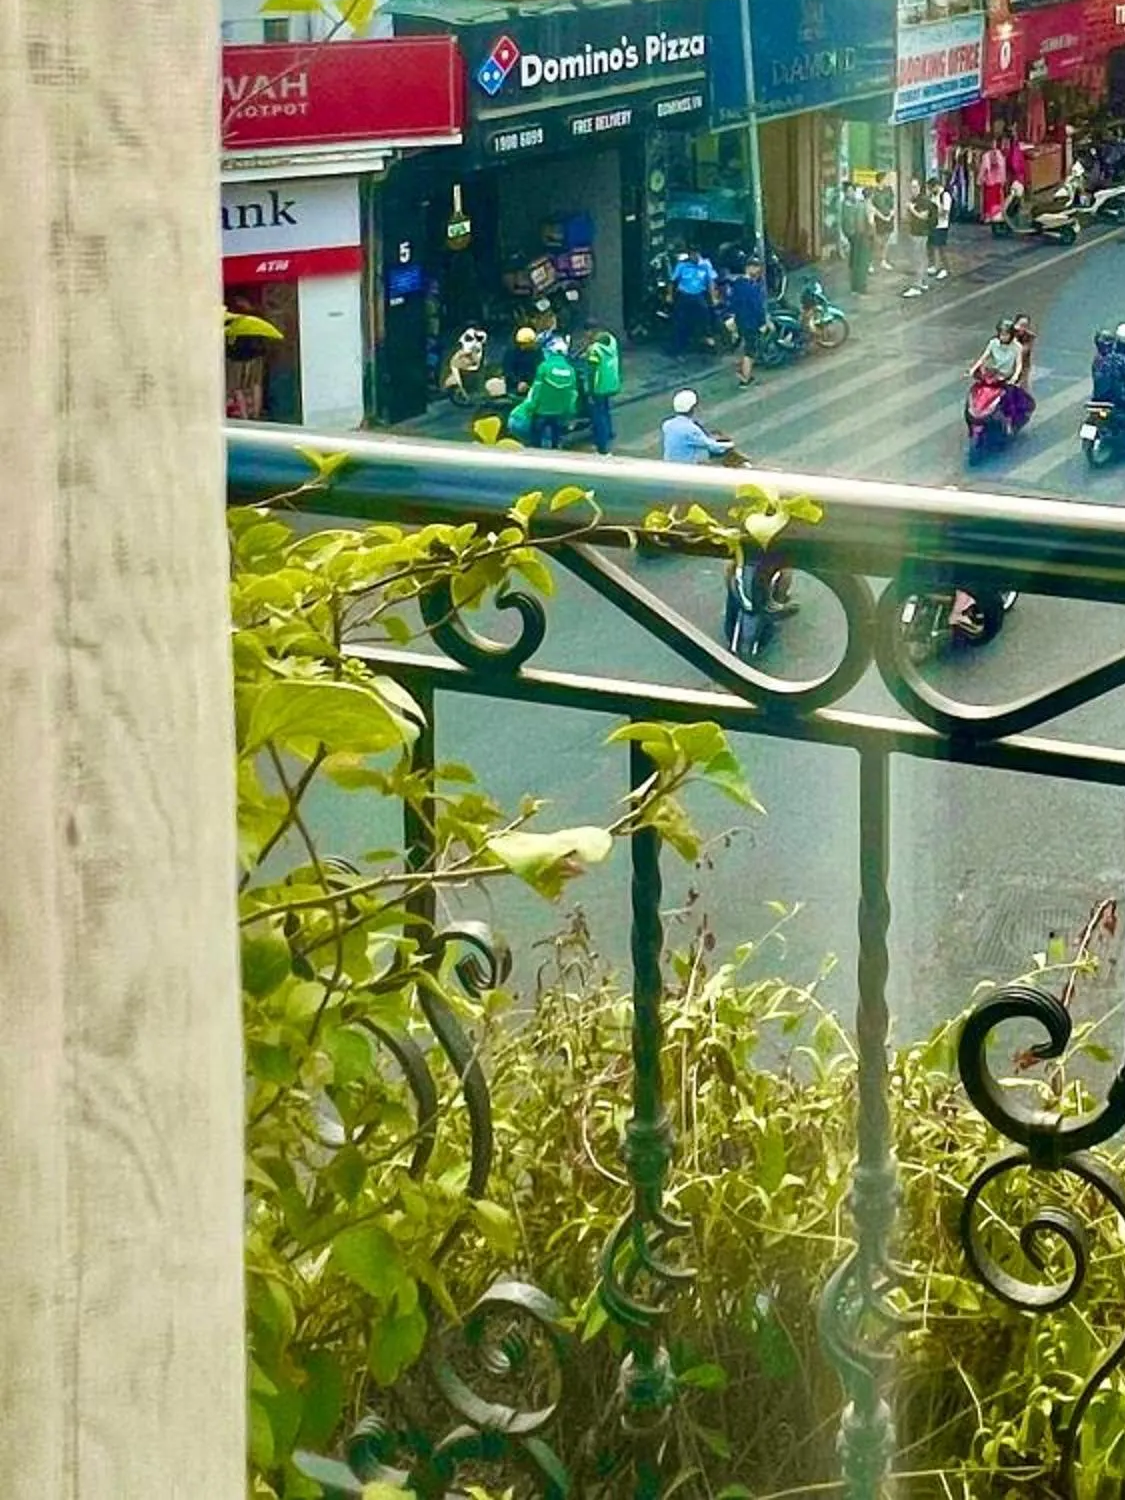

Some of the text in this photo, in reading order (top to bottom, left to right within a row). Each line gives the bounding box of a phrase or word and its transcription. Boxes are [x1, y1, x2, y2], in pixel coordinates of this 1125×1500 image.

[520, 31, 705, 88] Domino's Pizza
[572, 109, 633, 136] FREE DELIVERY
[400, 242, 411, 263] 5
[256, 259, 290, 273] ATM
